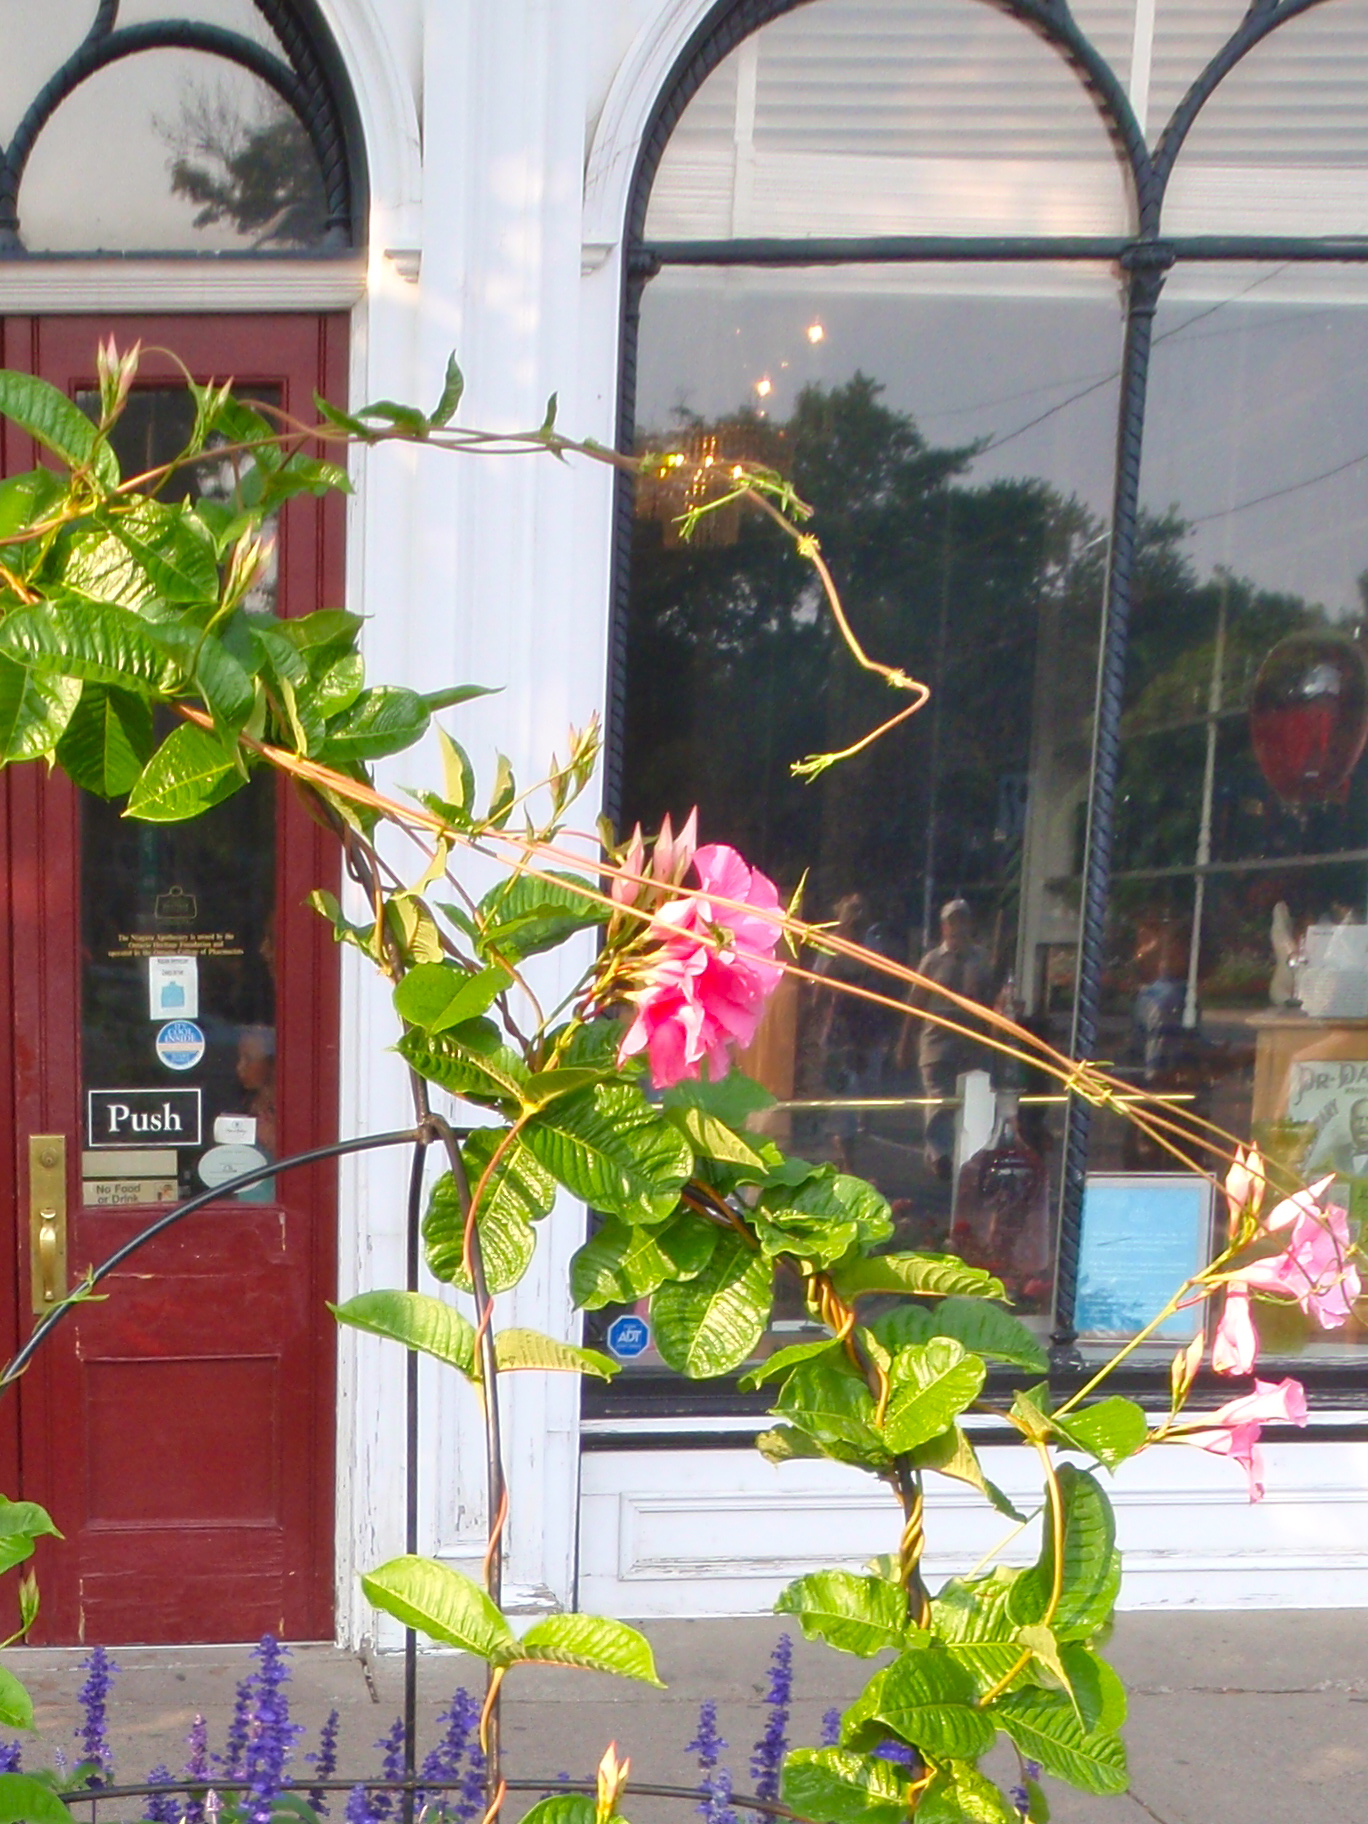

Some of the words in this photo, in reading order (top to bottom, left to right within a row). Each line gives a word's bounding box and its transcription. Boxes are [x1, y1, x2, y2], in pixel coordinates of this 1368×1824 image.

[106, 1102, 183, 1133] Push
[96, 1184, 111, 1195] No
[114, 1183, 141, 1195] Food
[97, 1196, 110, 1205] or
[111, 1194, 139, 1205] Drink
[617, 1329, 642, 1343] ADT
